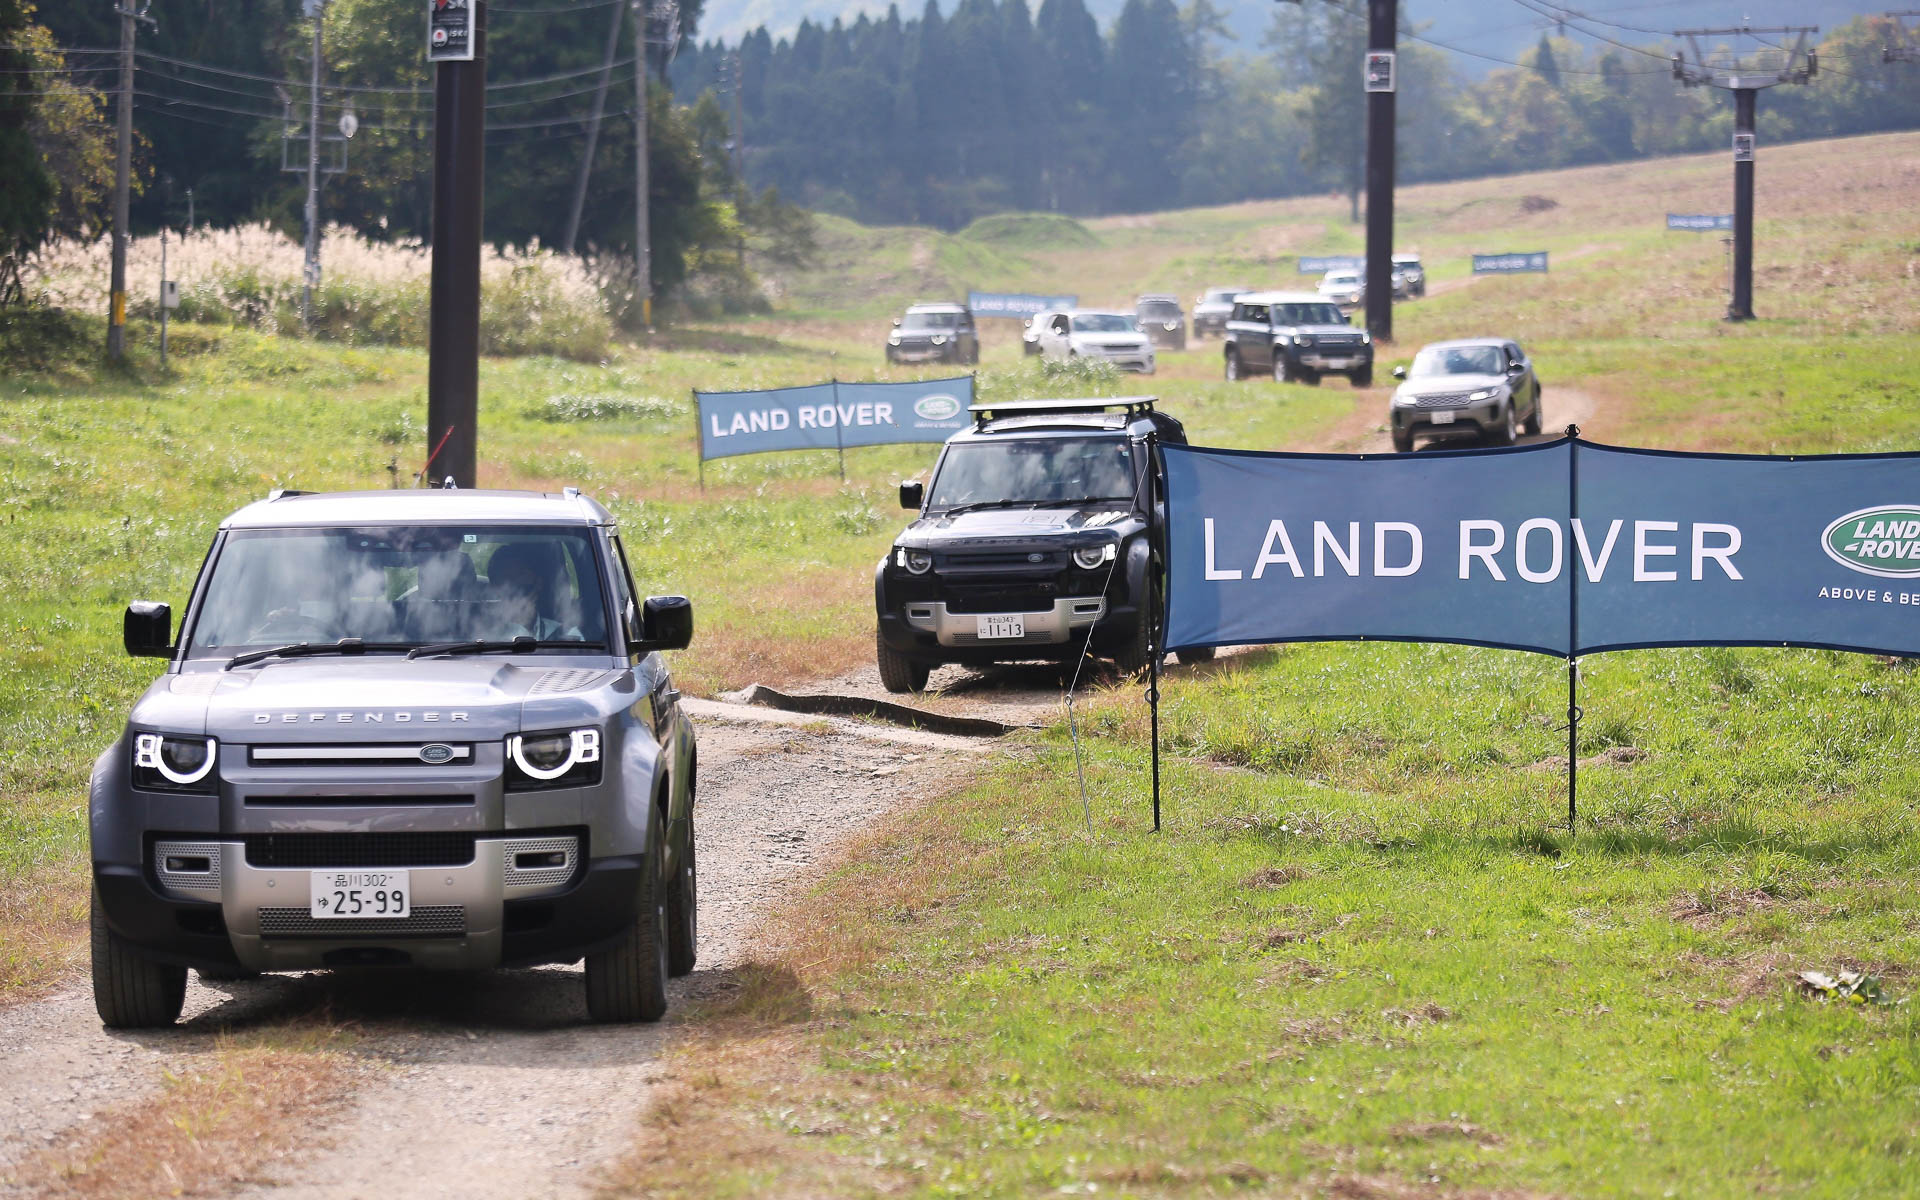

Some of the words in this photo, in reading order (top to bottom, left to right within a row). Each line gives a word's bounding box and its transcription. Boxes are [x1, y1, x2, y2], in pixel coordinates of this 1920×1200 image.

[711, 408, 790, 438] LAND
[798, 401, 895, 430] ROVER
[1853, 520, 1920, 539] LAND
[1204, 518, 1423, 581] LAND
[1458, 517, 1744, 583] ROVER
[1818, 586, 1877, 602] ABOVE
[1882, 591, 1893, 603] &
[989, 623, 1022, 637] 11-13
[253, 711, 470, 724] DEFENDER
[333, 890, 404, 915] 25-99
